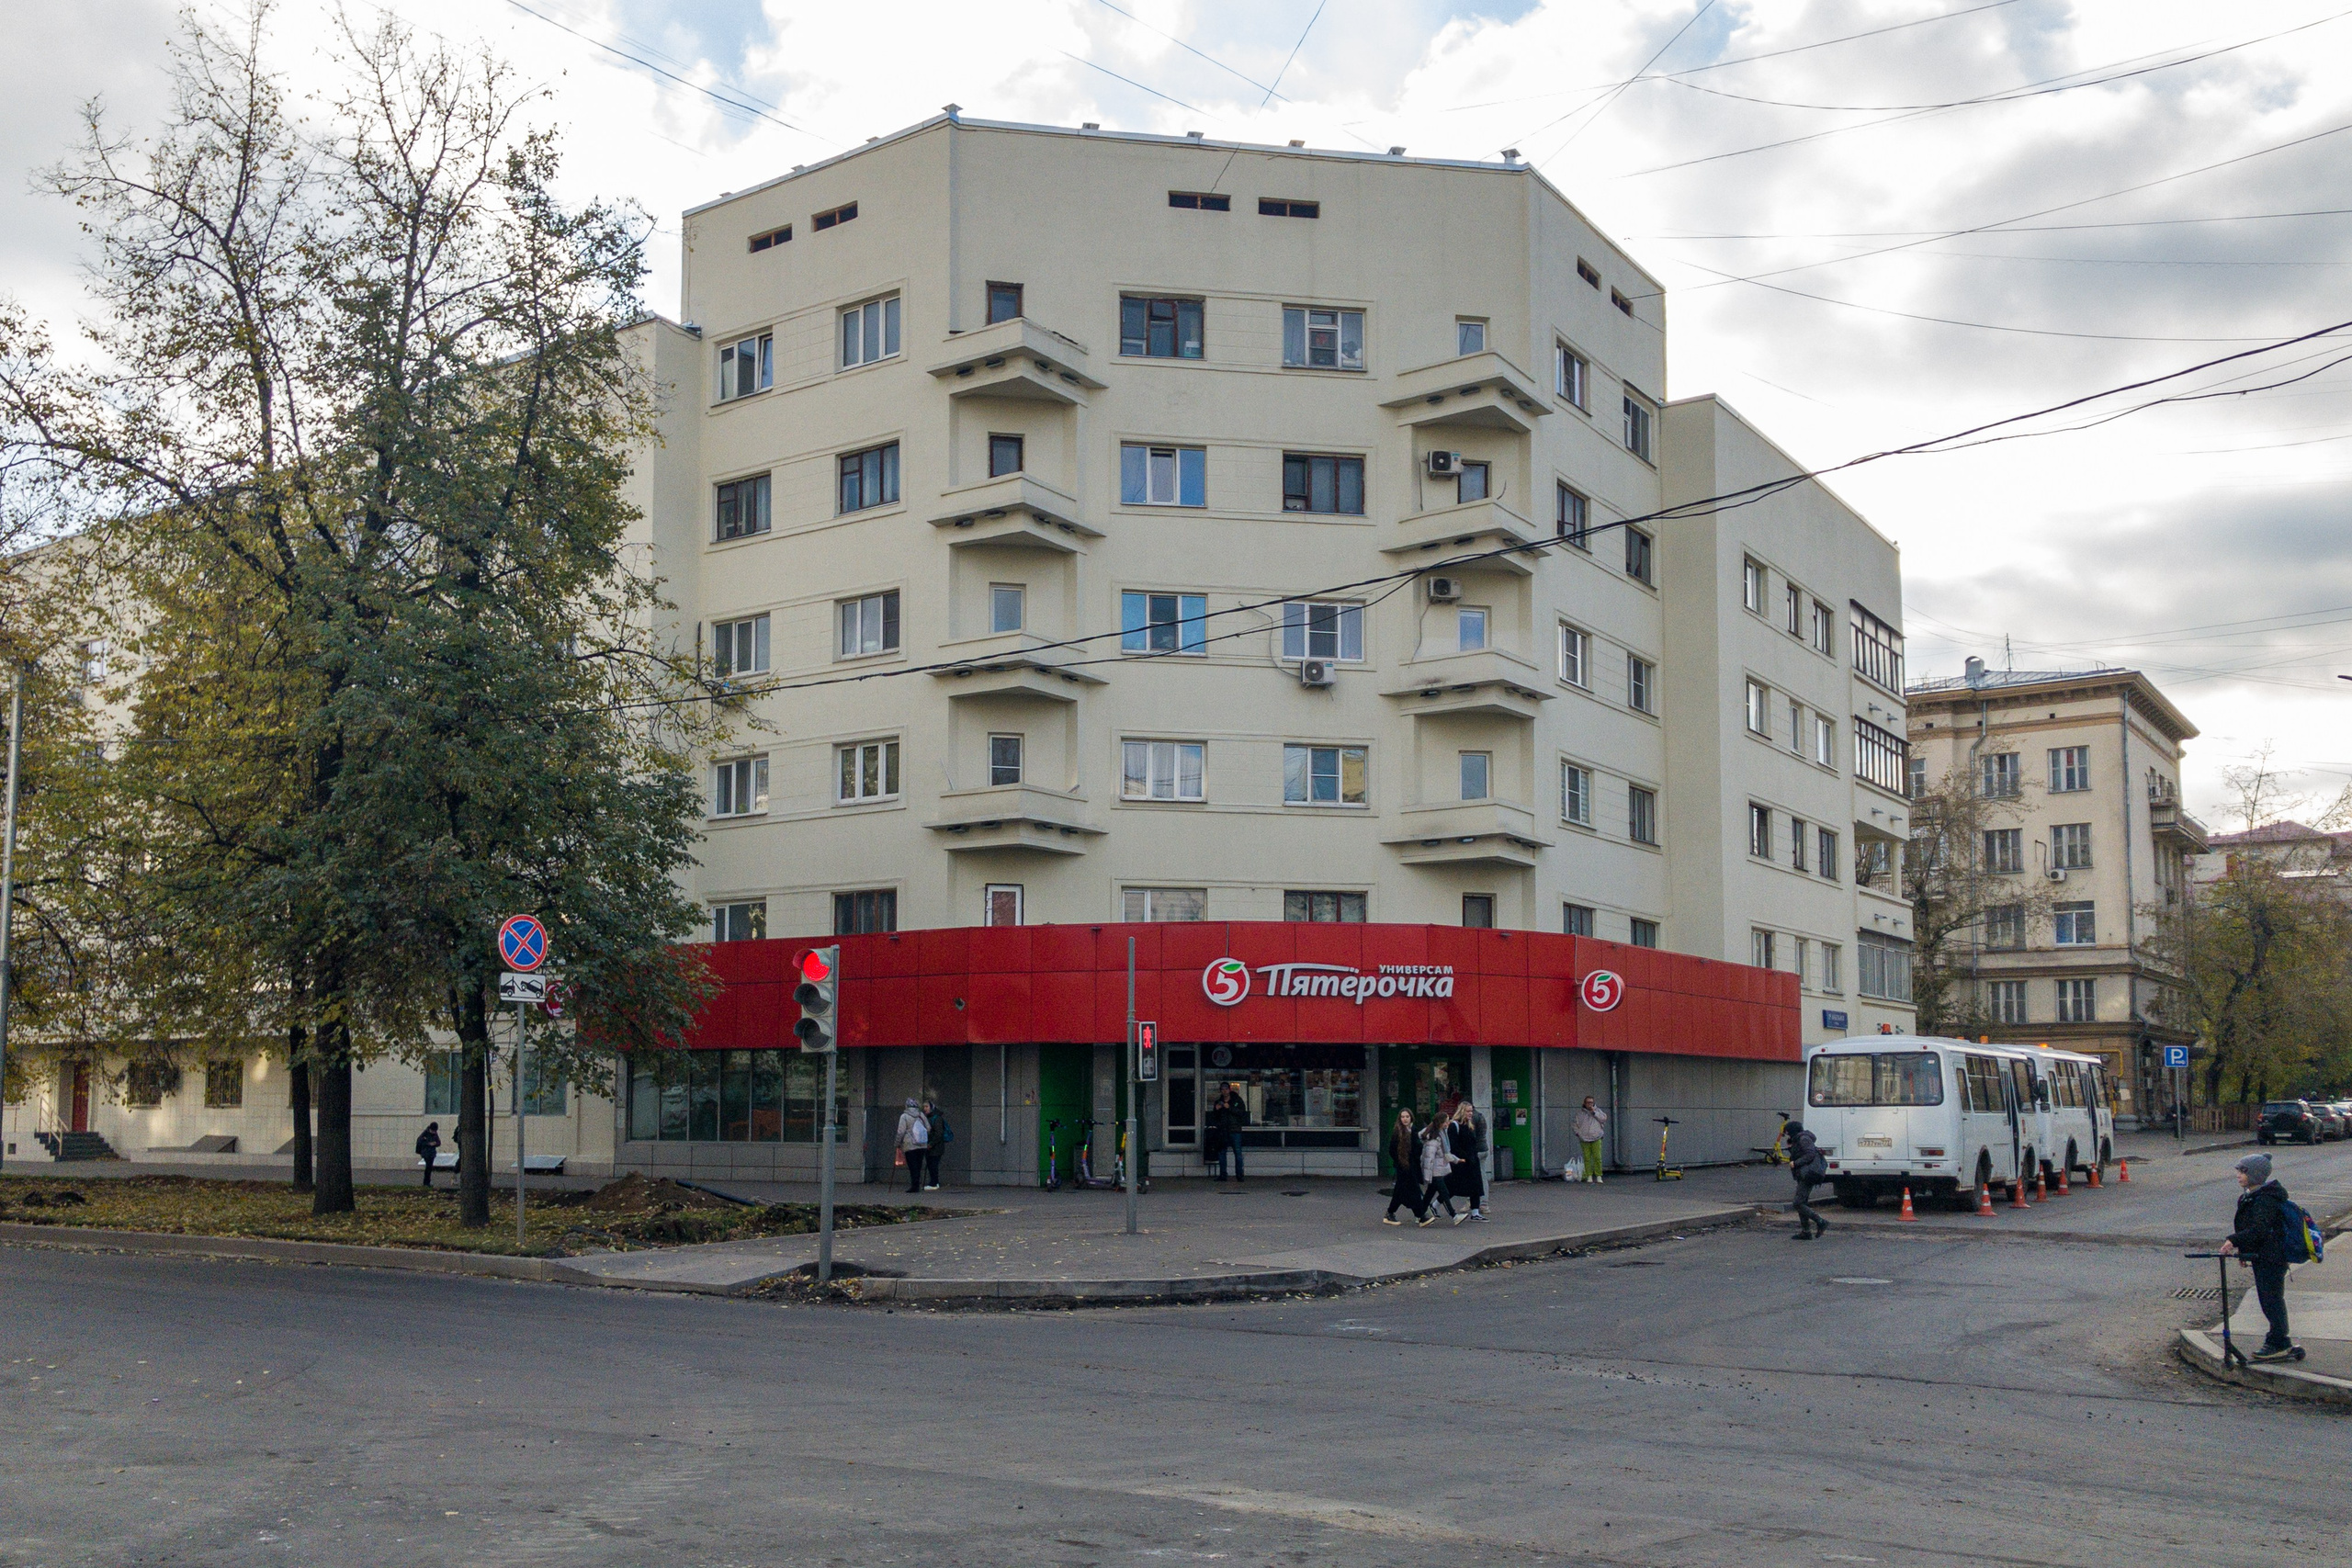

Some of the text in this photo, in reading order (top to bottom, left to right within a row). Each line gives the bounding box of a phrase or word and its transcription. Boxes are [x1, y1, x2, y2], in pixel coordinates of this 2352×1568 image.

[1379, 964, 1453, 975] УНИВЕРСАМ
[1212, 961, 1246, 1001] 5
[2171, 1048, 2183, 1065] P
